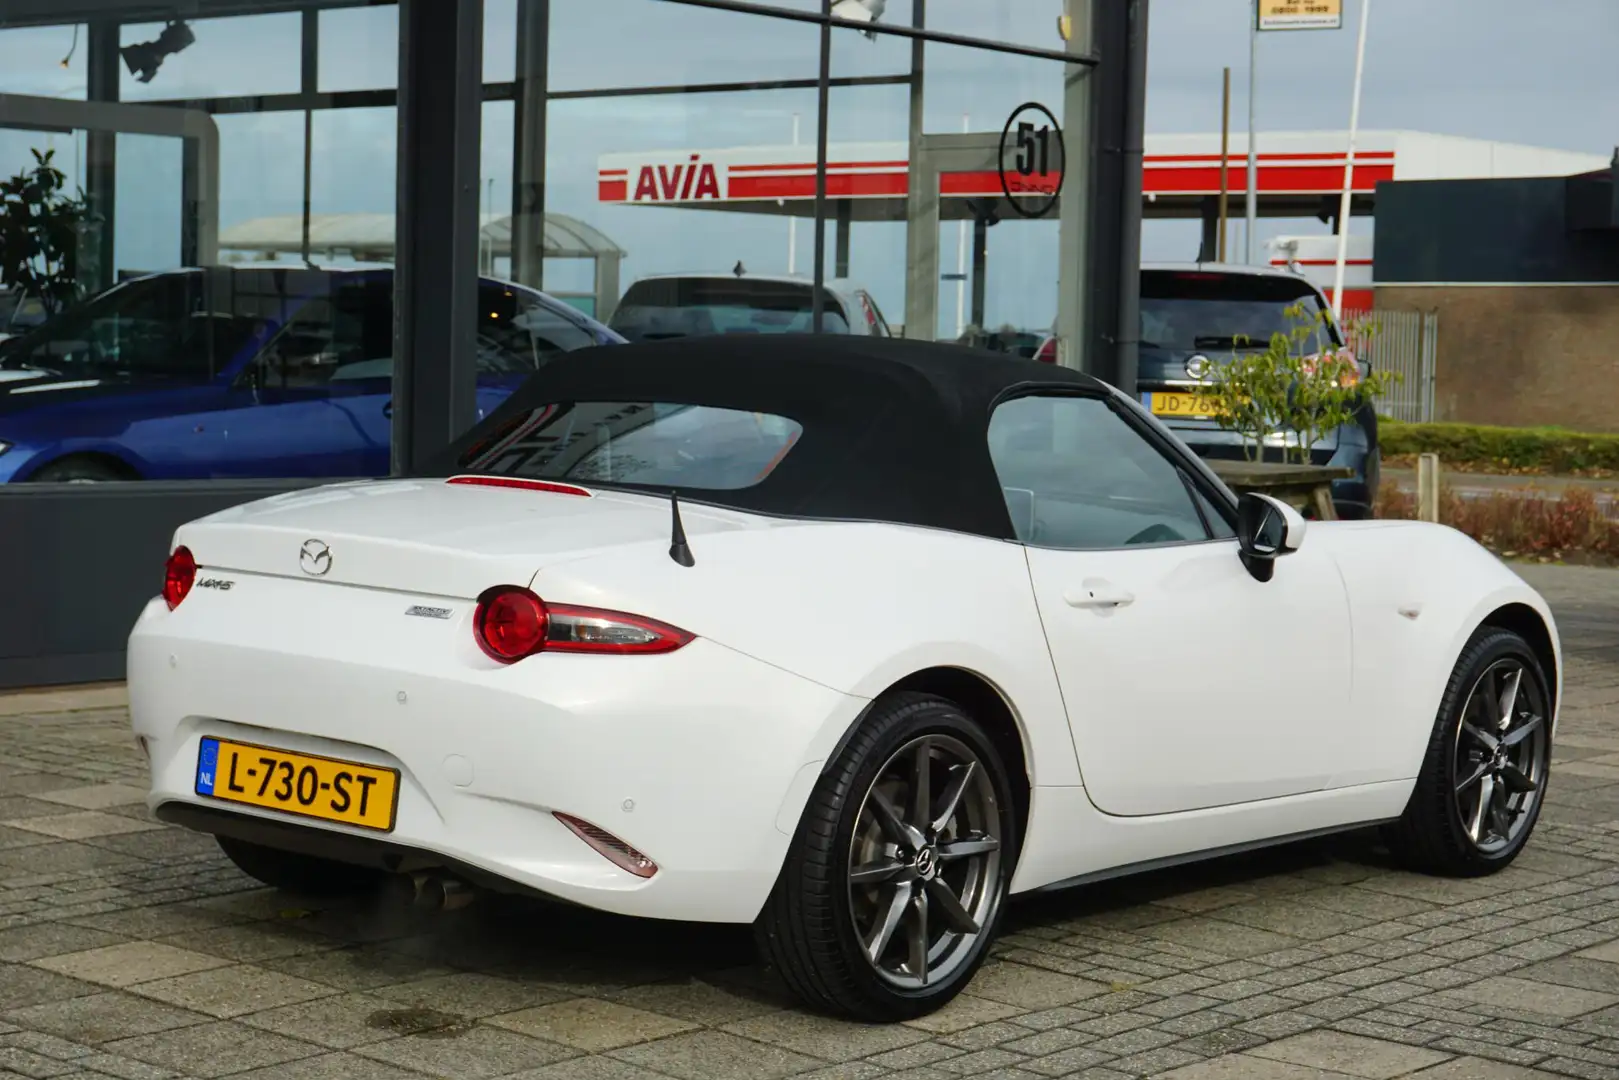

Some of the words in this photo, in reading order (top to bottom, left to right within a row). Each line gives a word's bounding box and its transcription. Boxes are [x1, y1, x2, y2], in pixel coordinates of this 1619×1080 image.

[1016, 121, 1048, 177] 51
[200, 771, 213, 786] NL
[228, 752, 377, 817] L-730-ST
